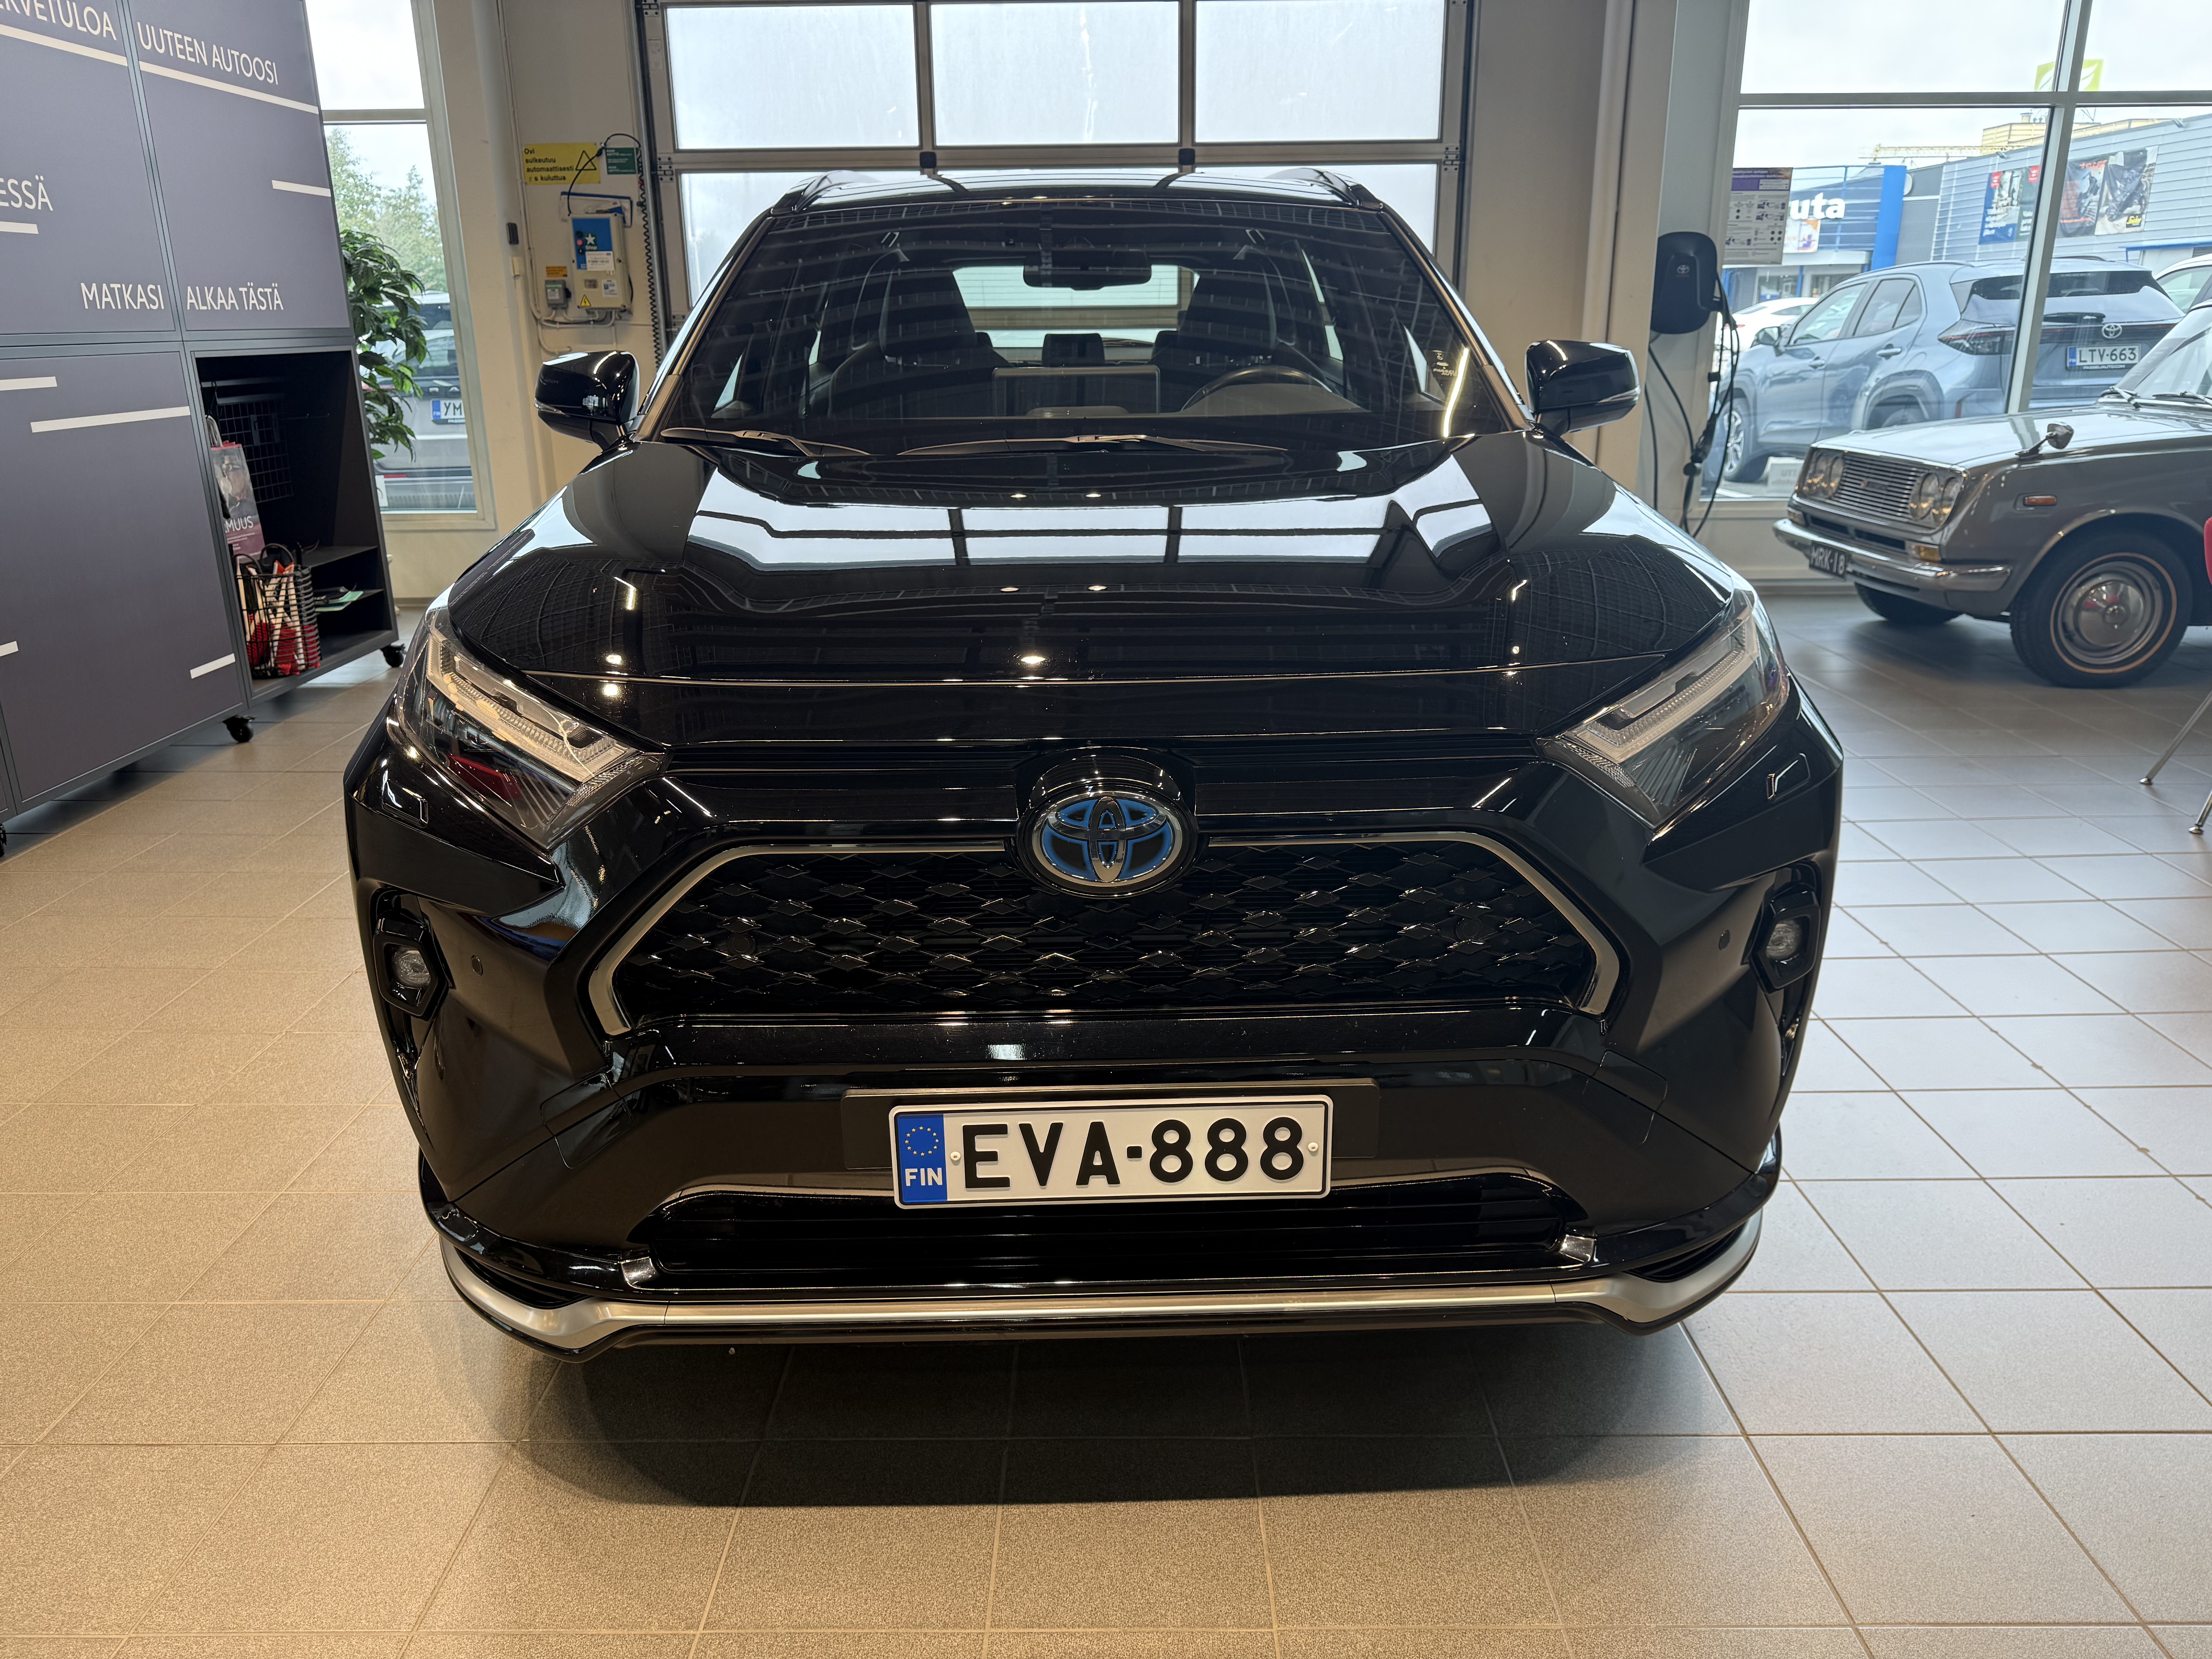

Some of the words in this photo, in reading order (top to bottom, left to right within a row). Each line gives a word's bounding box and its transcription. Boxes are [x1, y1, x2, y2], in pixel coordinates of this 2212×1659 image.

[137, 22, 208, 65] UUTEEN
[213, 44, 278, 85] AUTOOSI
[1790, 192, 1846, 220] uta
[81, 283, 165, 309] MATKASI
[187, 286, 239, 310] ALKAA
[239, 282, 283, 310] TÄSTÄ
[2079, 348, 2136, 363] LTV-663
[224, 515, 254, 533] MUUS
[962, 1116, 1304, 1189] EVA-888
[905, 1167, 943, 1187] FIN
